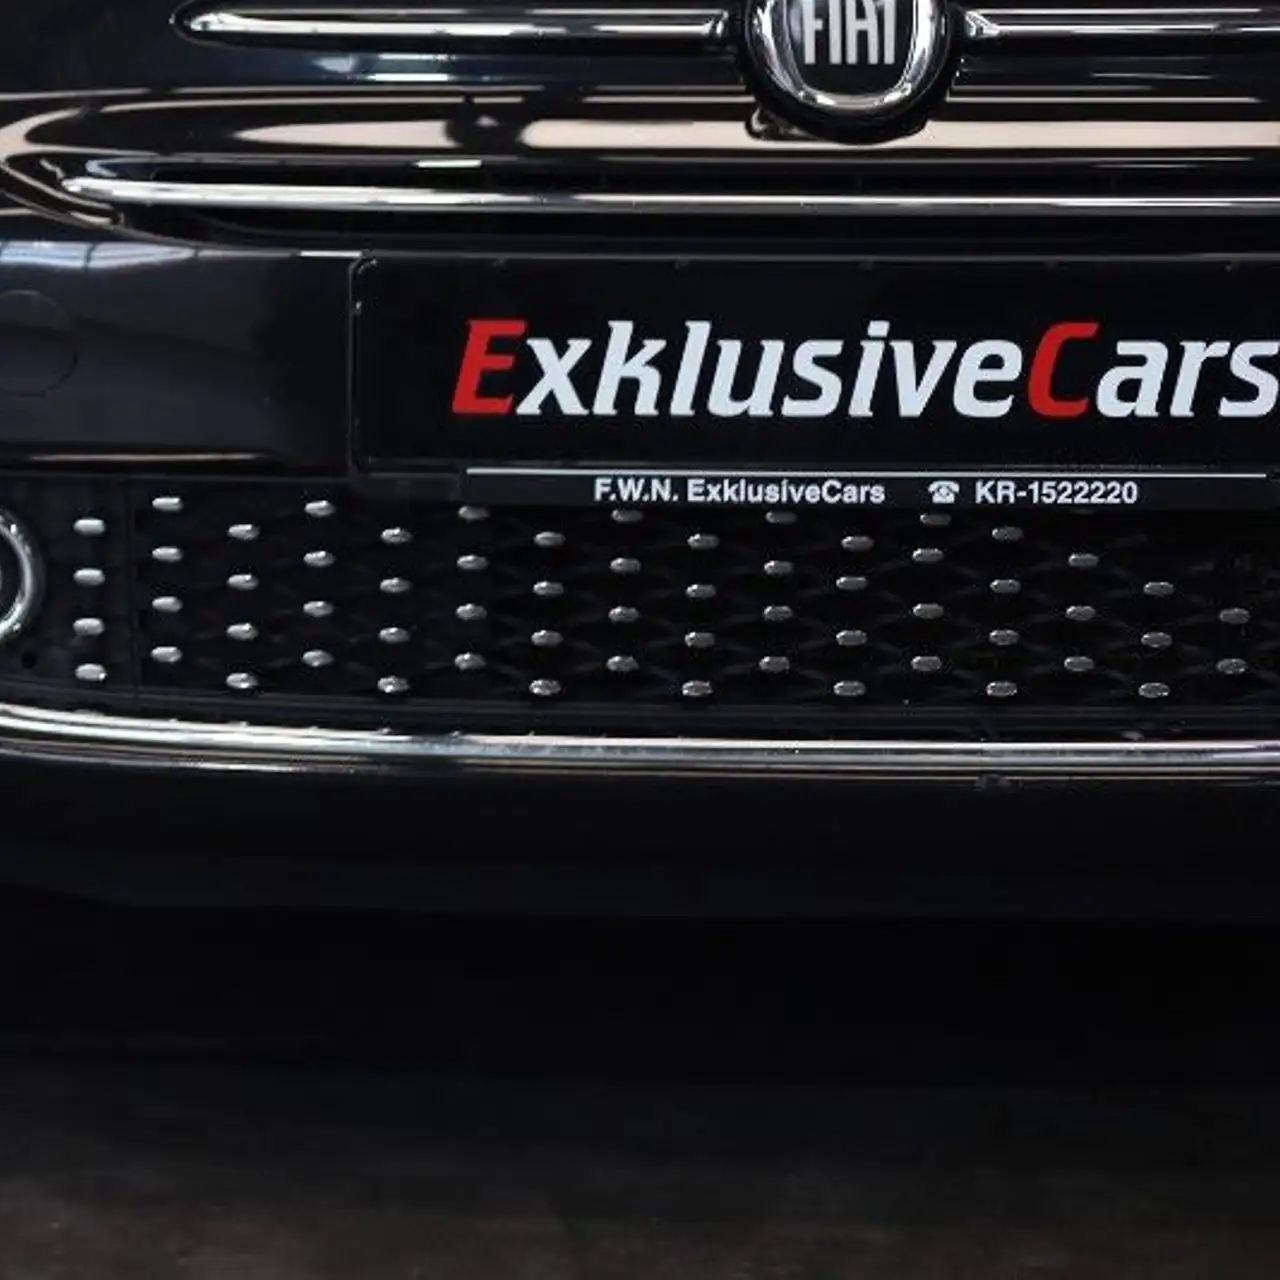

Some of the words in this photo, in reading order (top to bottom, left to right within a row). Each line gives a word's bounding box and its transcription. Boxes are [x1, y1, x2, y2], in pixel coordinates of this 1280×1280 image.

[451, 319, 1280, 418] ExklusiveCars
[594, 477, 679, 503] F.W.N.
[687, 477, 886, 504] ExklusiveCars
[975, 480, 1138, 505] KR-1522220
